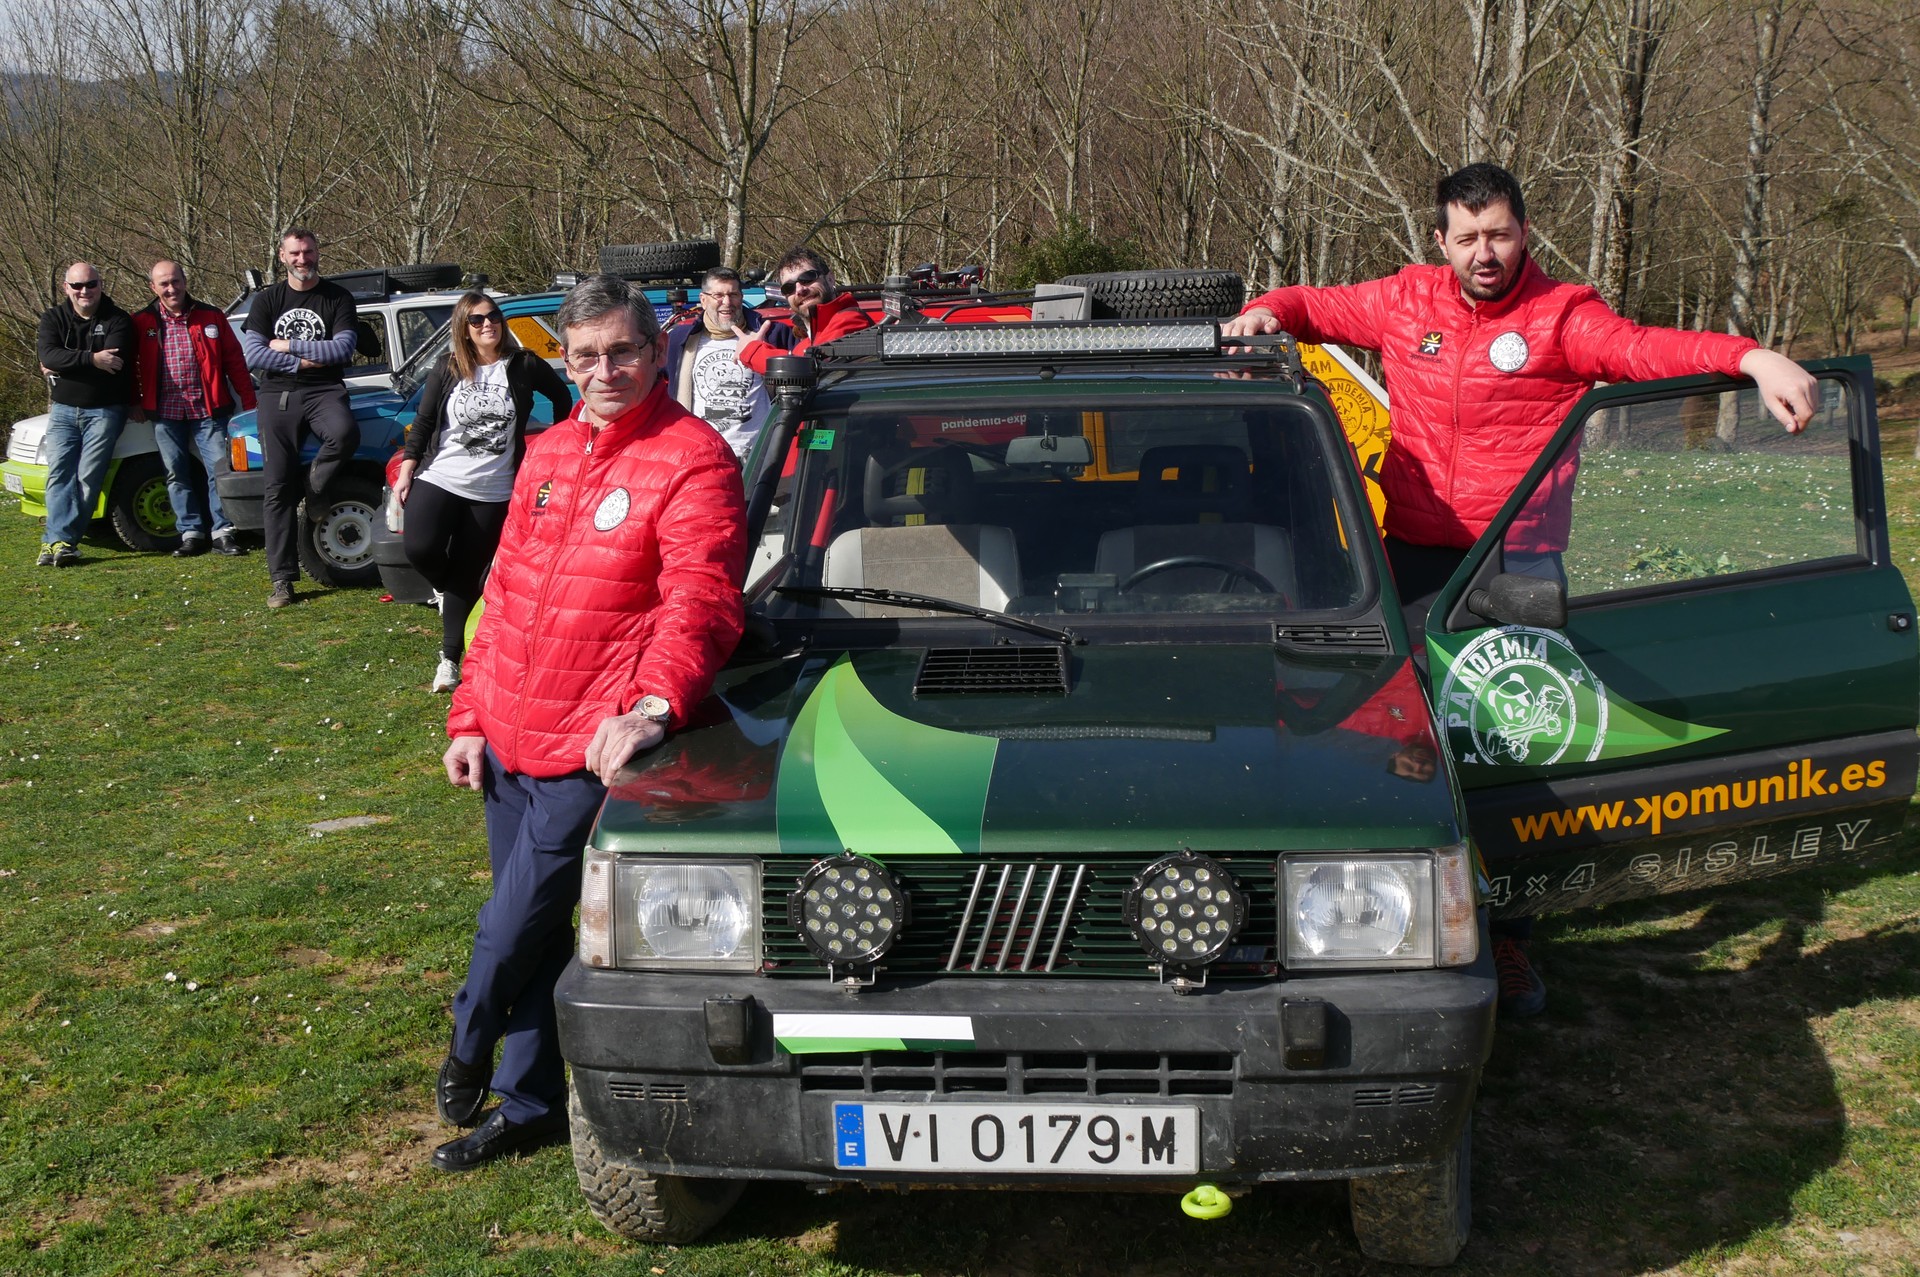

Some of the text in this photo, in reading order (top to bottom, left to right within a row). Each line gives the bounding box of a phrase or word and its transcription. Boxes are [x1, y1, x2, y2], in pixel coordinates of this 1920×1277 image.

[279, 310, 318, 327] PANDEMIA
[697, 352, 735, 377] PANDEMI
[1328, 382, 1372, 414] ANDEMIA
[1448, 635, 1548, 728] PANDEMIA
[1628, 819, 1872, 884] SISLEY
[845, 1142, 859, 1157] E
